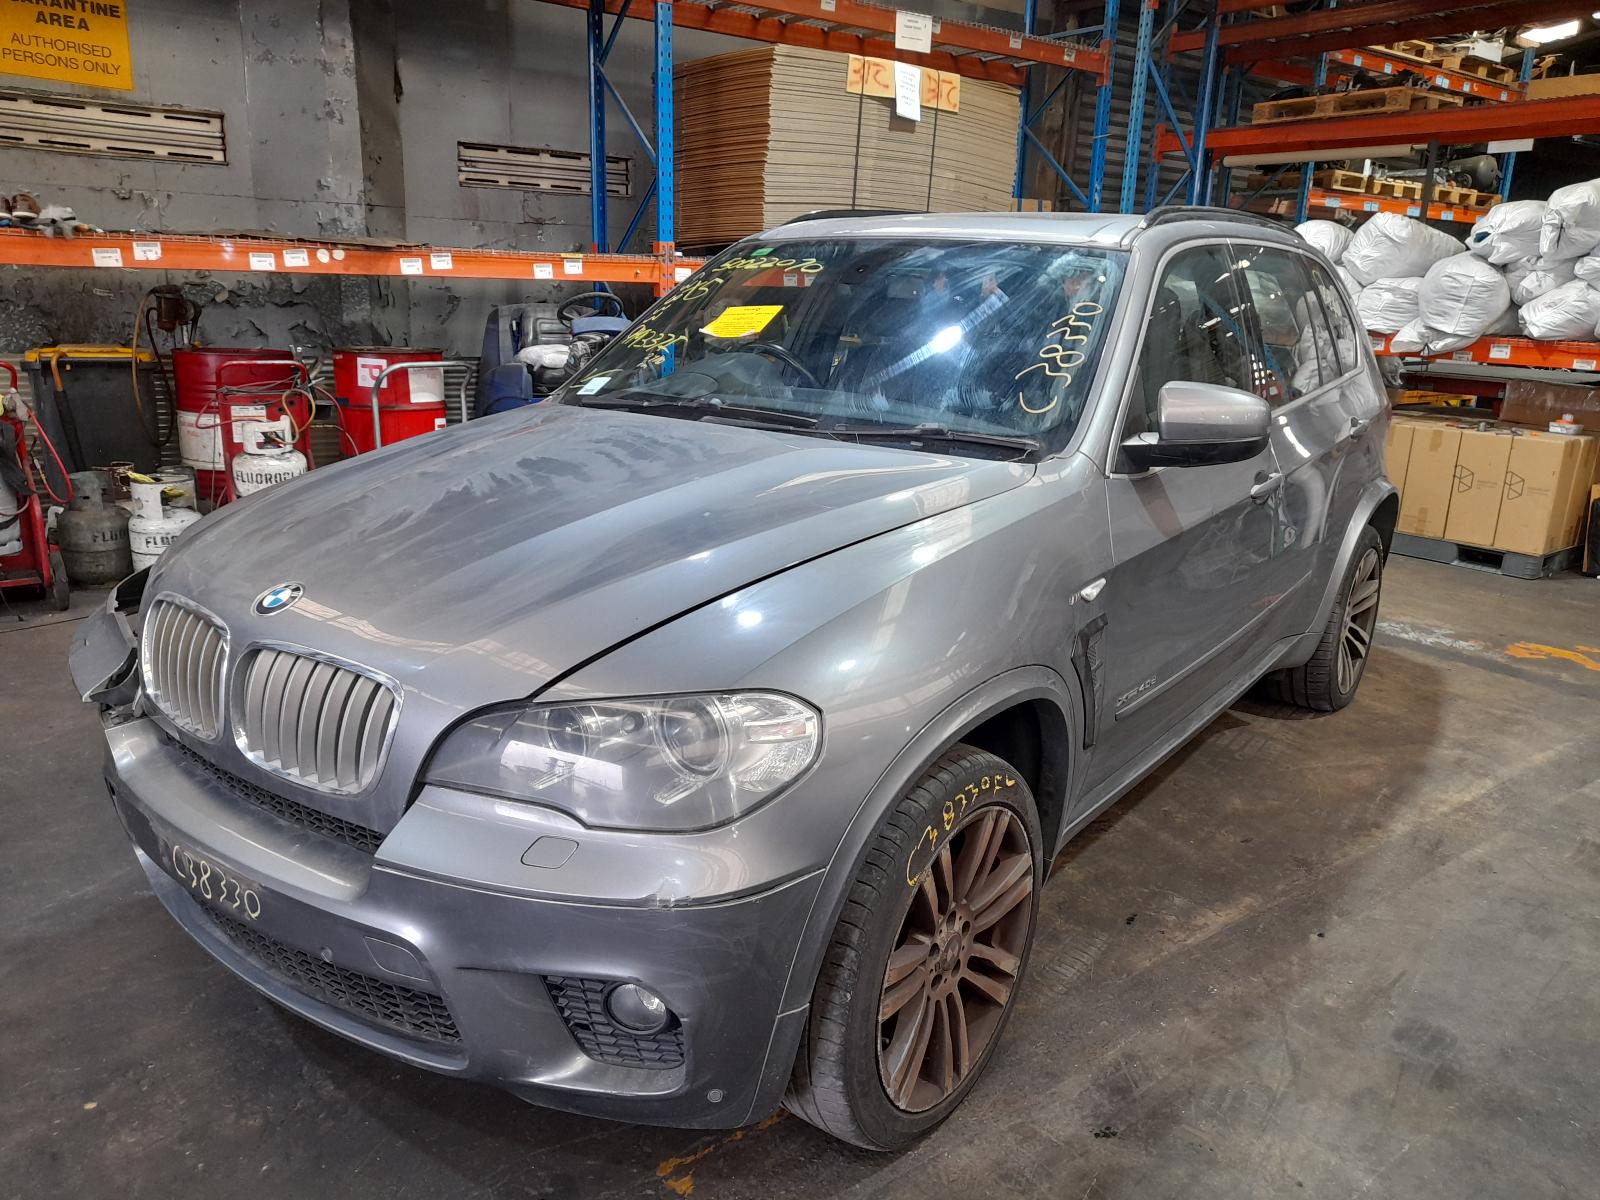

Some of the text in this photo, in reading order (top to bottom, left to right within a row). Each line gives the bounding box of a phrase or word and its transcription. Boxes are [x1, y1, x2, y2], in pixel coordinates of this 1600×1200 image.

[10, 0, 121, 18] ANTINE
[35, 10, 91, 31] AREA
[10, 32, 112, 59] AUTHORISED
[2, 47, 121, 75] PERSONS ONLY
[172, 844, 262, 921] C38330
